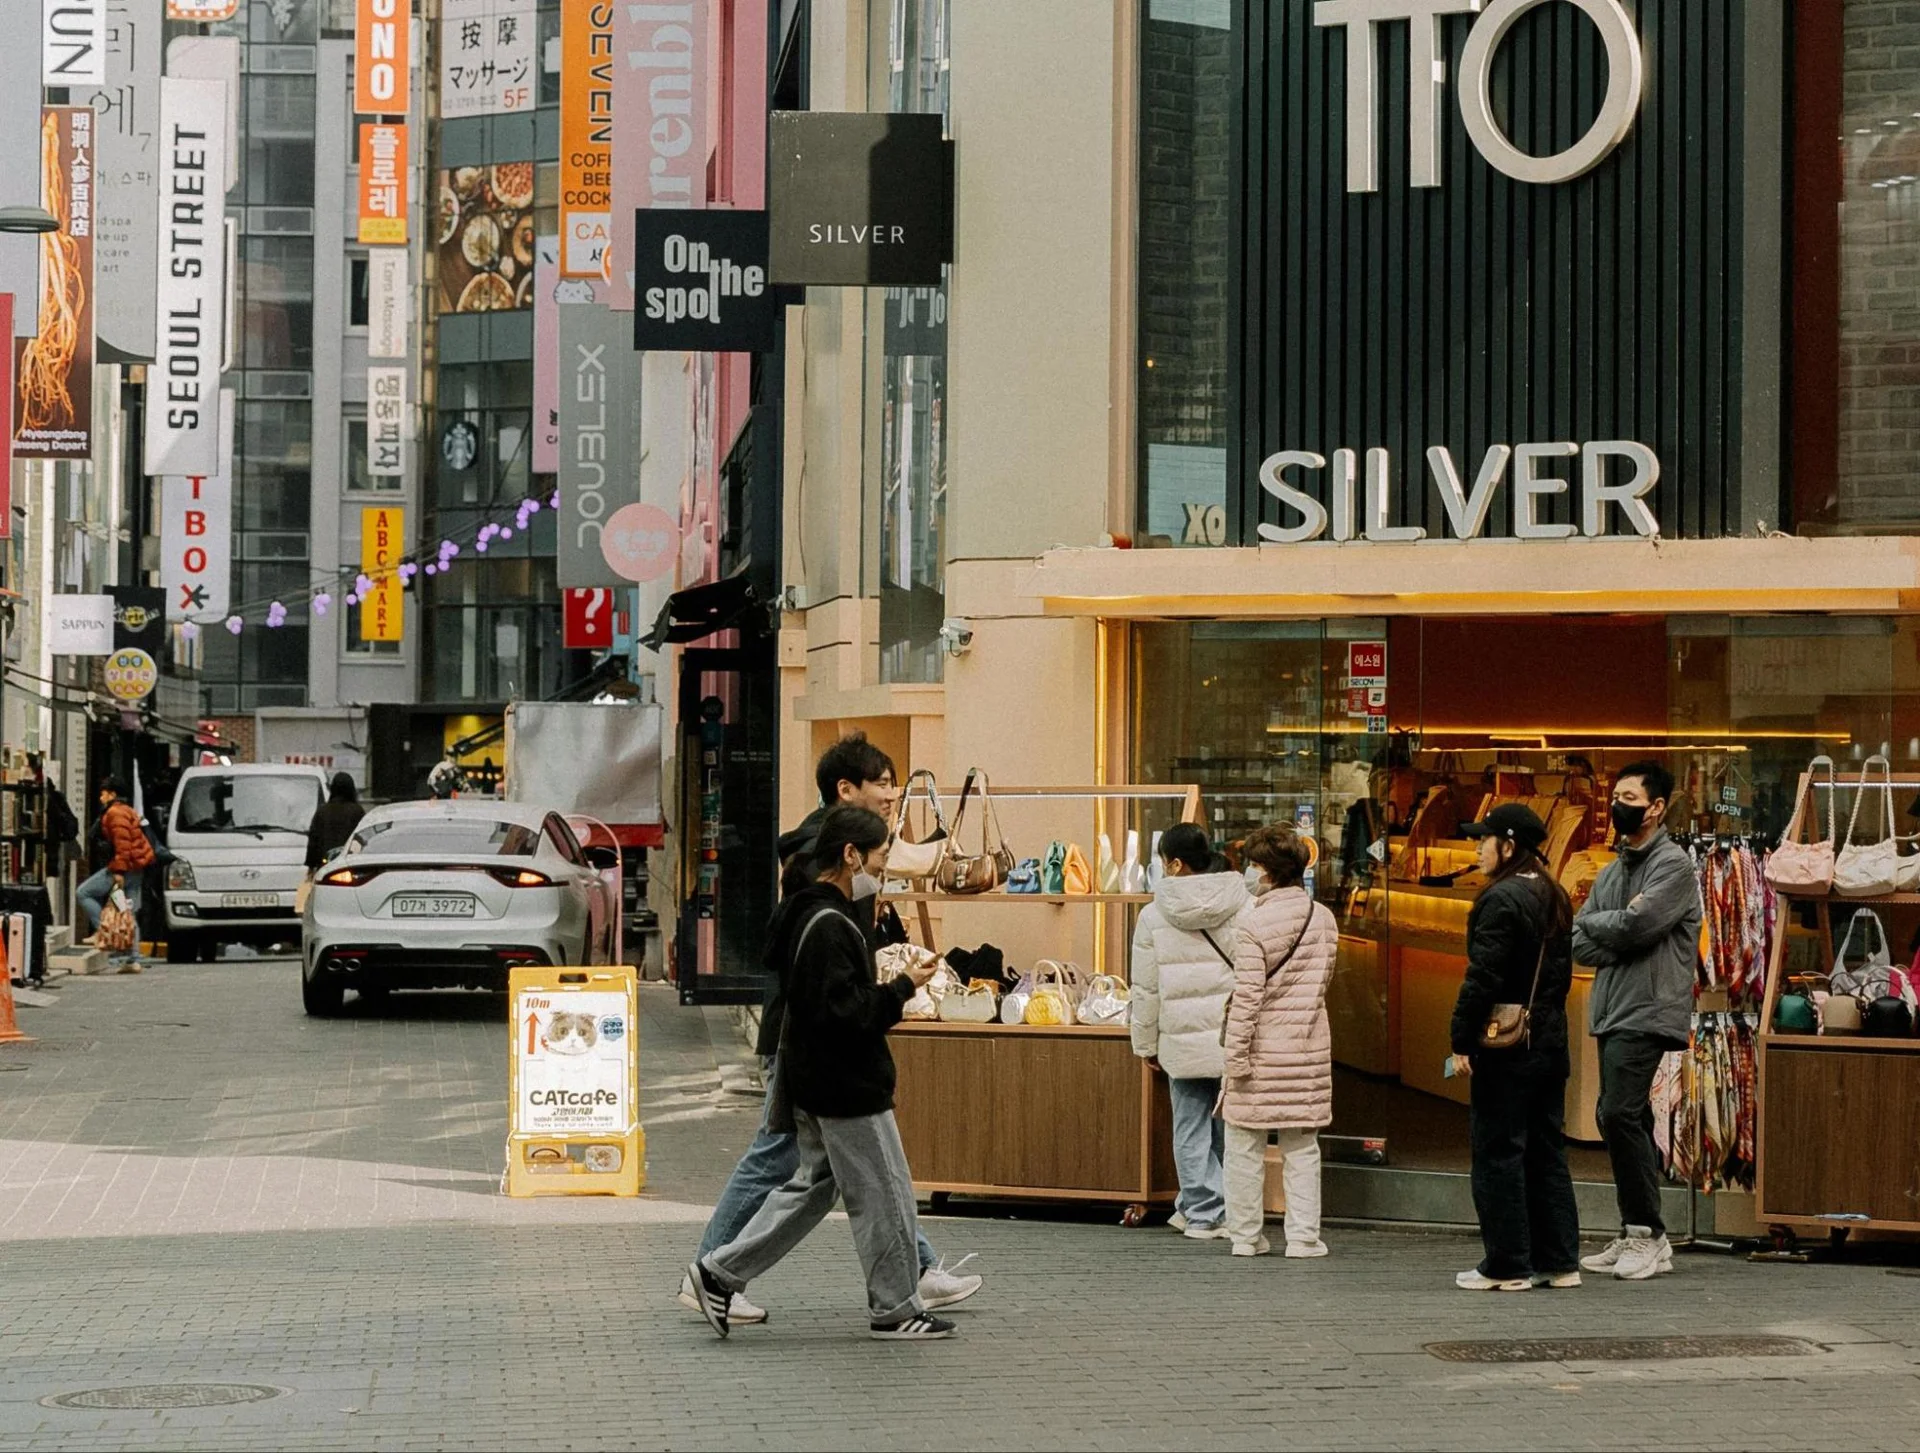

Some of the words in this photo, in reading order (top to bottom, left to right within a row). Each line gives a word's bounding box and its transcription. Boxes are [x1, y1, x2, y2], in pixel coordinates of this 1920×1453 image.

[49, 0, 93, 74] UN
[449, 57, 529, 89] マッサージ
[503, 87, 529, 108] 5F
[1314, 0, 1641, 192] TTO
[571, 153, 612, 168] COF
[170, 123, 206, 279] STREET
[808, 223, 905, 244] SILVER
[663, 234, 709, 273] On
[709, 258, 764, 297] the
[168, 296, 202, 431] SEOUL
[21, 429, 88, 441] Myeongdong
[51, 441, 88, 452] Depart
[1257, 440, 1660, 543] SILVER
[1181, 503, 1226, 547] XO
[1354, 654, 1381, 667] 에스원
[1714, 803, 1742, 817] OPEN
[432, 899, 467, 912] 3972
[525, 997, 551, 1009] 10m
[529, 1089, 618, 1106] CATcafe
